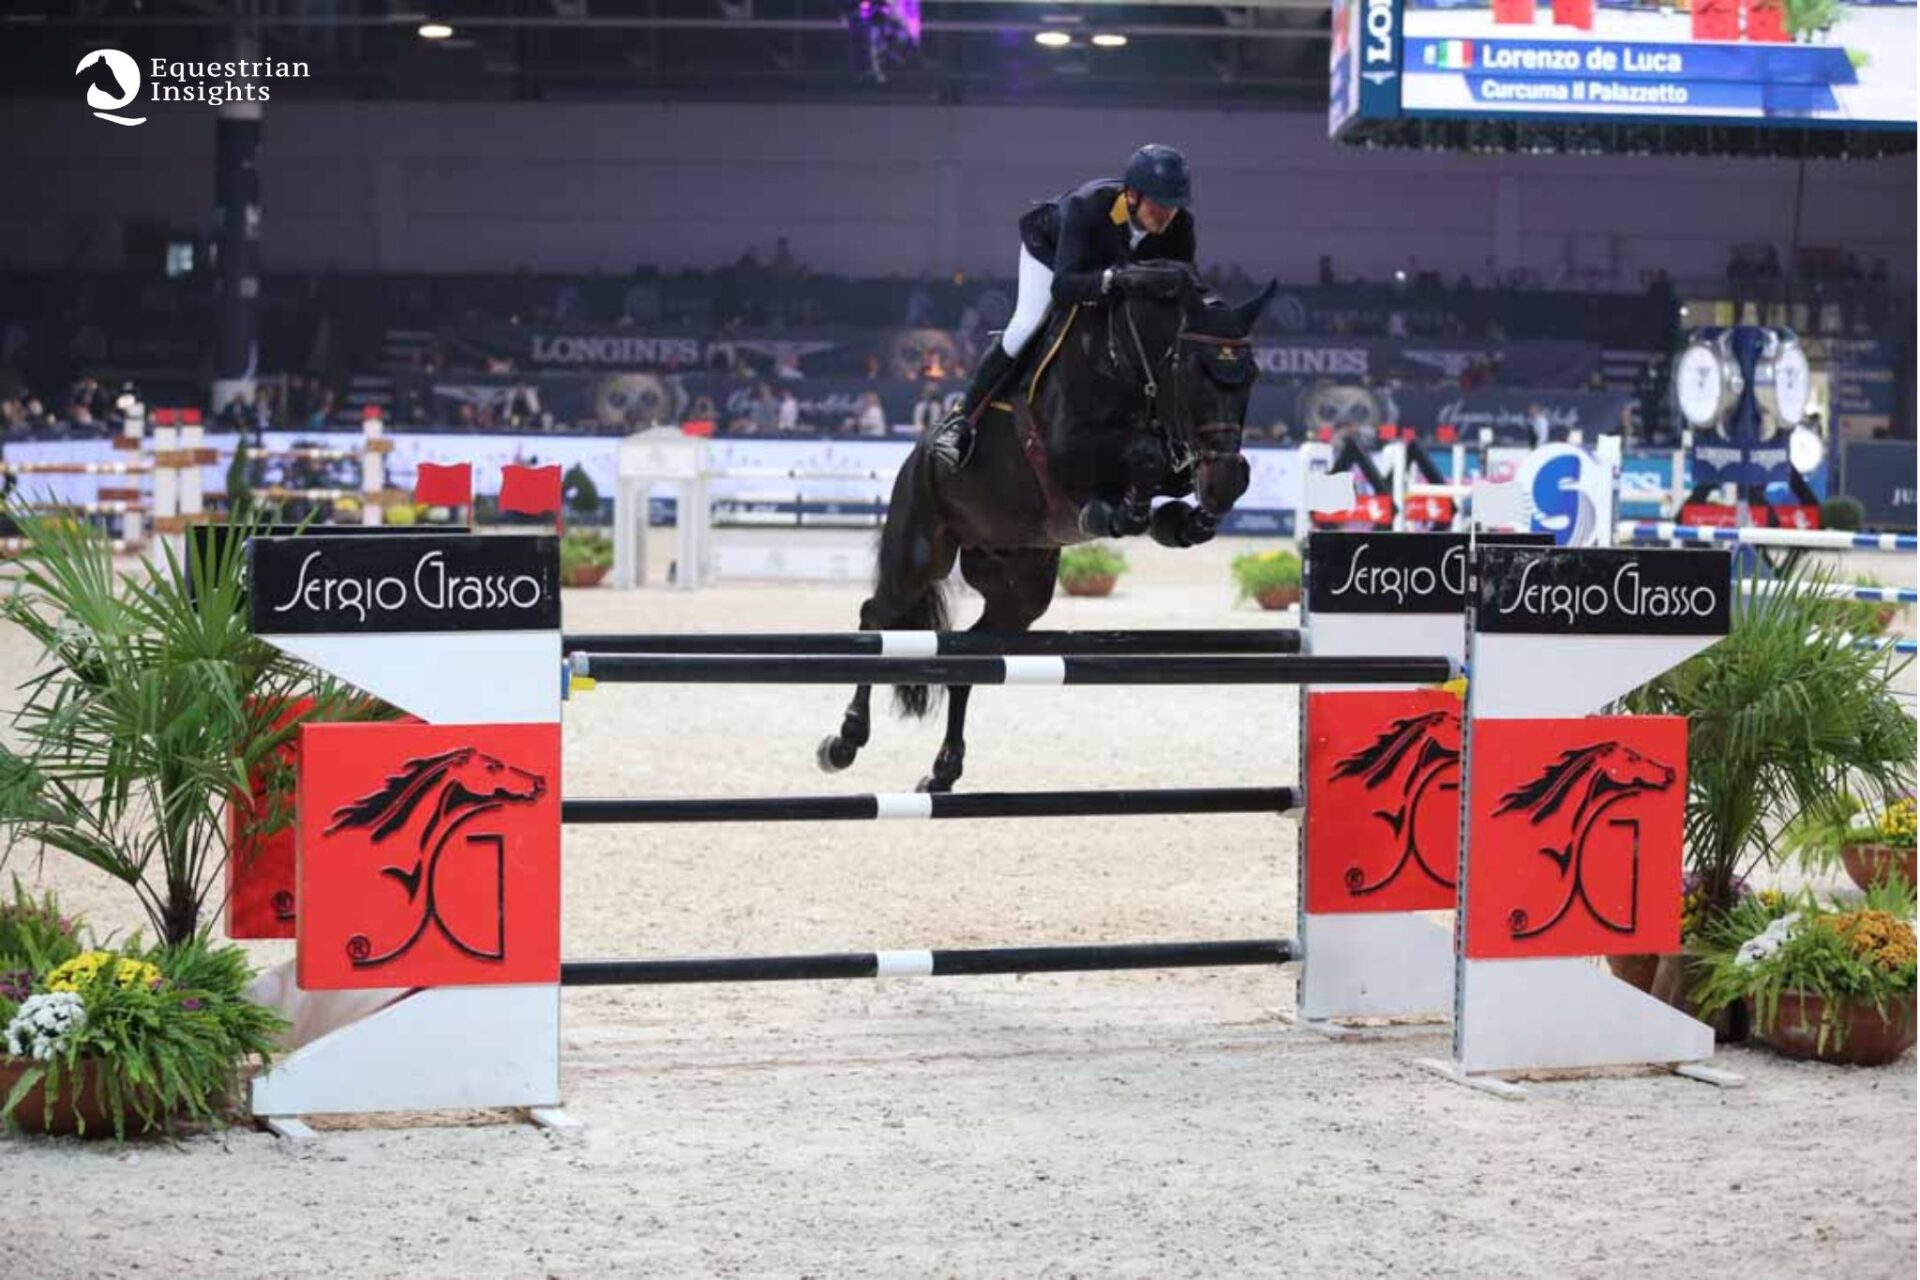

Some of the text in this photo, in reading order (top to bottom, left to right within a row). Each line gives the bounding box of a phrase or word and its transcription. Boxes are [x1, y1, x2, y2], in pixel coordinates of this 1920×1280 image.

[1482, 44, 1682, 72] Lorenzo de Luca
[1481, 80, 1569, 99] Curcuma
[1589, 82, 1688, 103] Palazzetto
[532, 337, 700, 363] LONGINES
[275, 550, 542, 622] Sergio Grasso
[1331, 543, 1436, 604] Sergio
[1499, 559, 1717, 625] Sergio Grasso
